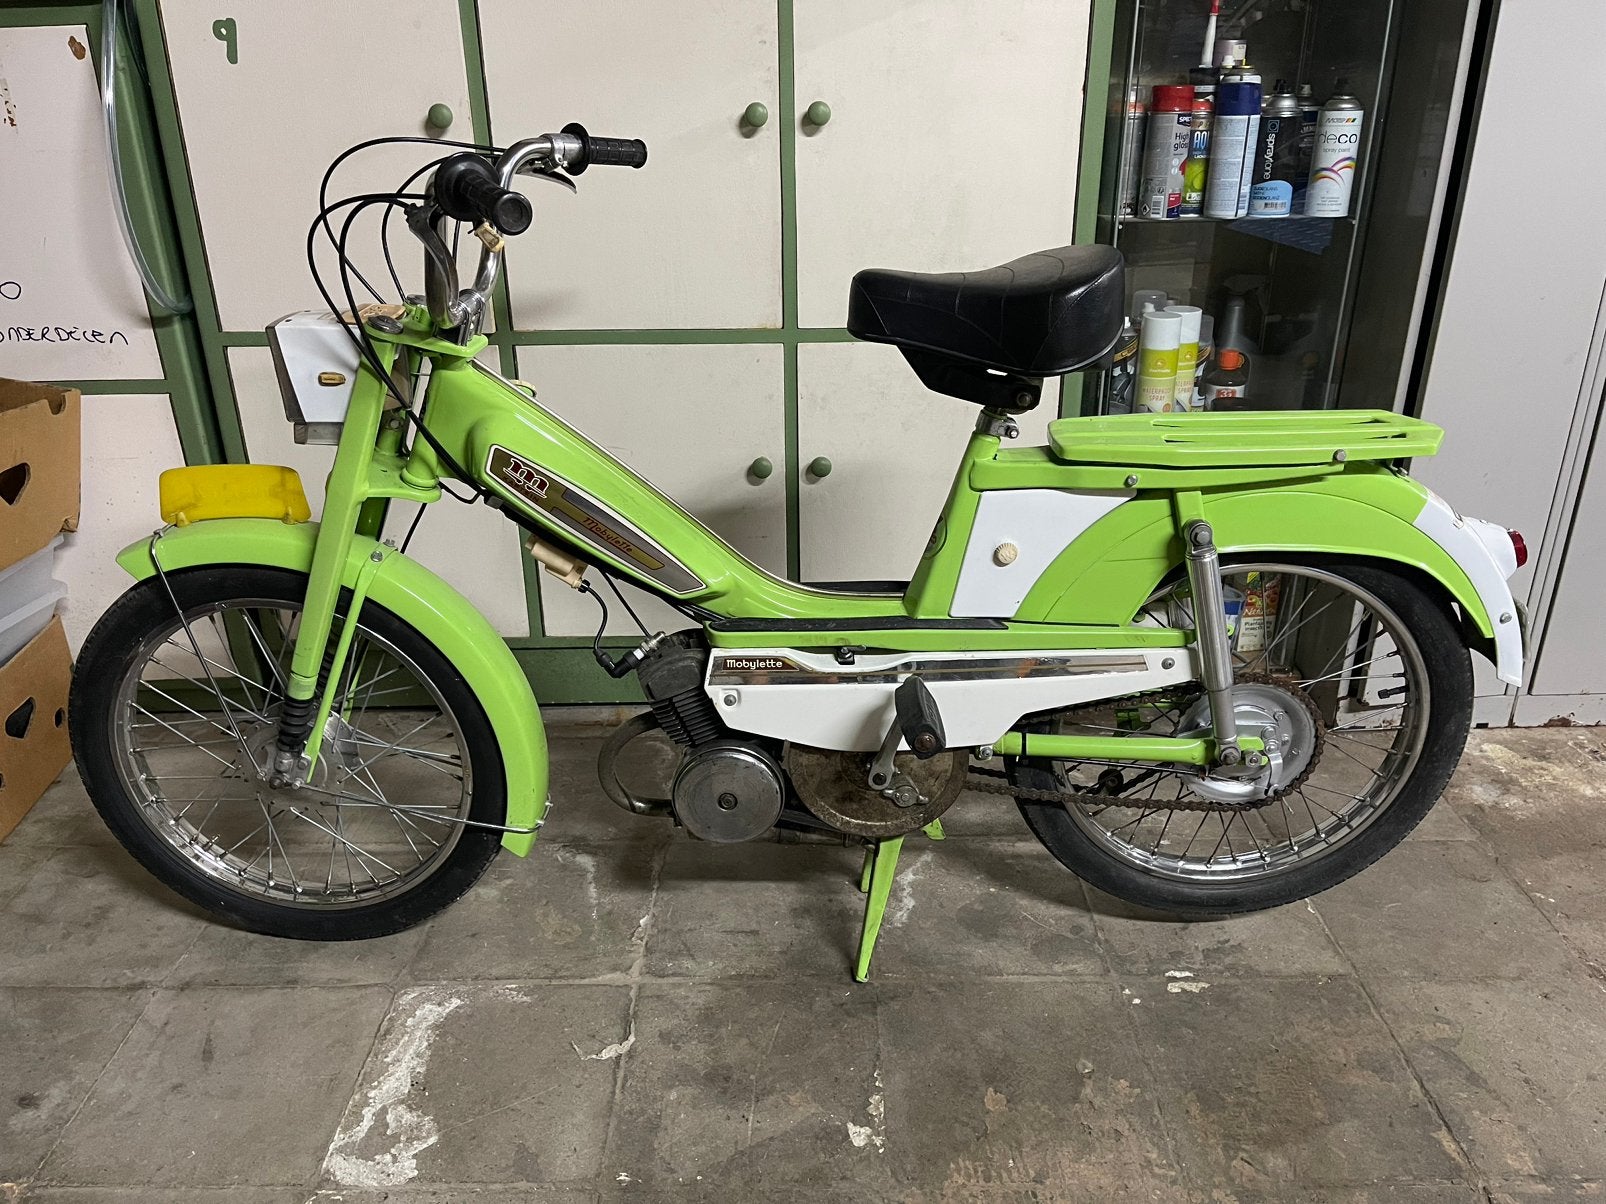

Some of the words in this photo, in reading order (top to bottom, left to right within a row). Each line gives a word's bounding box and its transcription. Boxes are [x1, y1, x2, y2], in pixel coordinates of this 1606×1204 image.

[1318, 131, 1358, 144] deco
[582, 517, 634, 553] Mobylette
[726, 659, 783, 670] Mobylette
